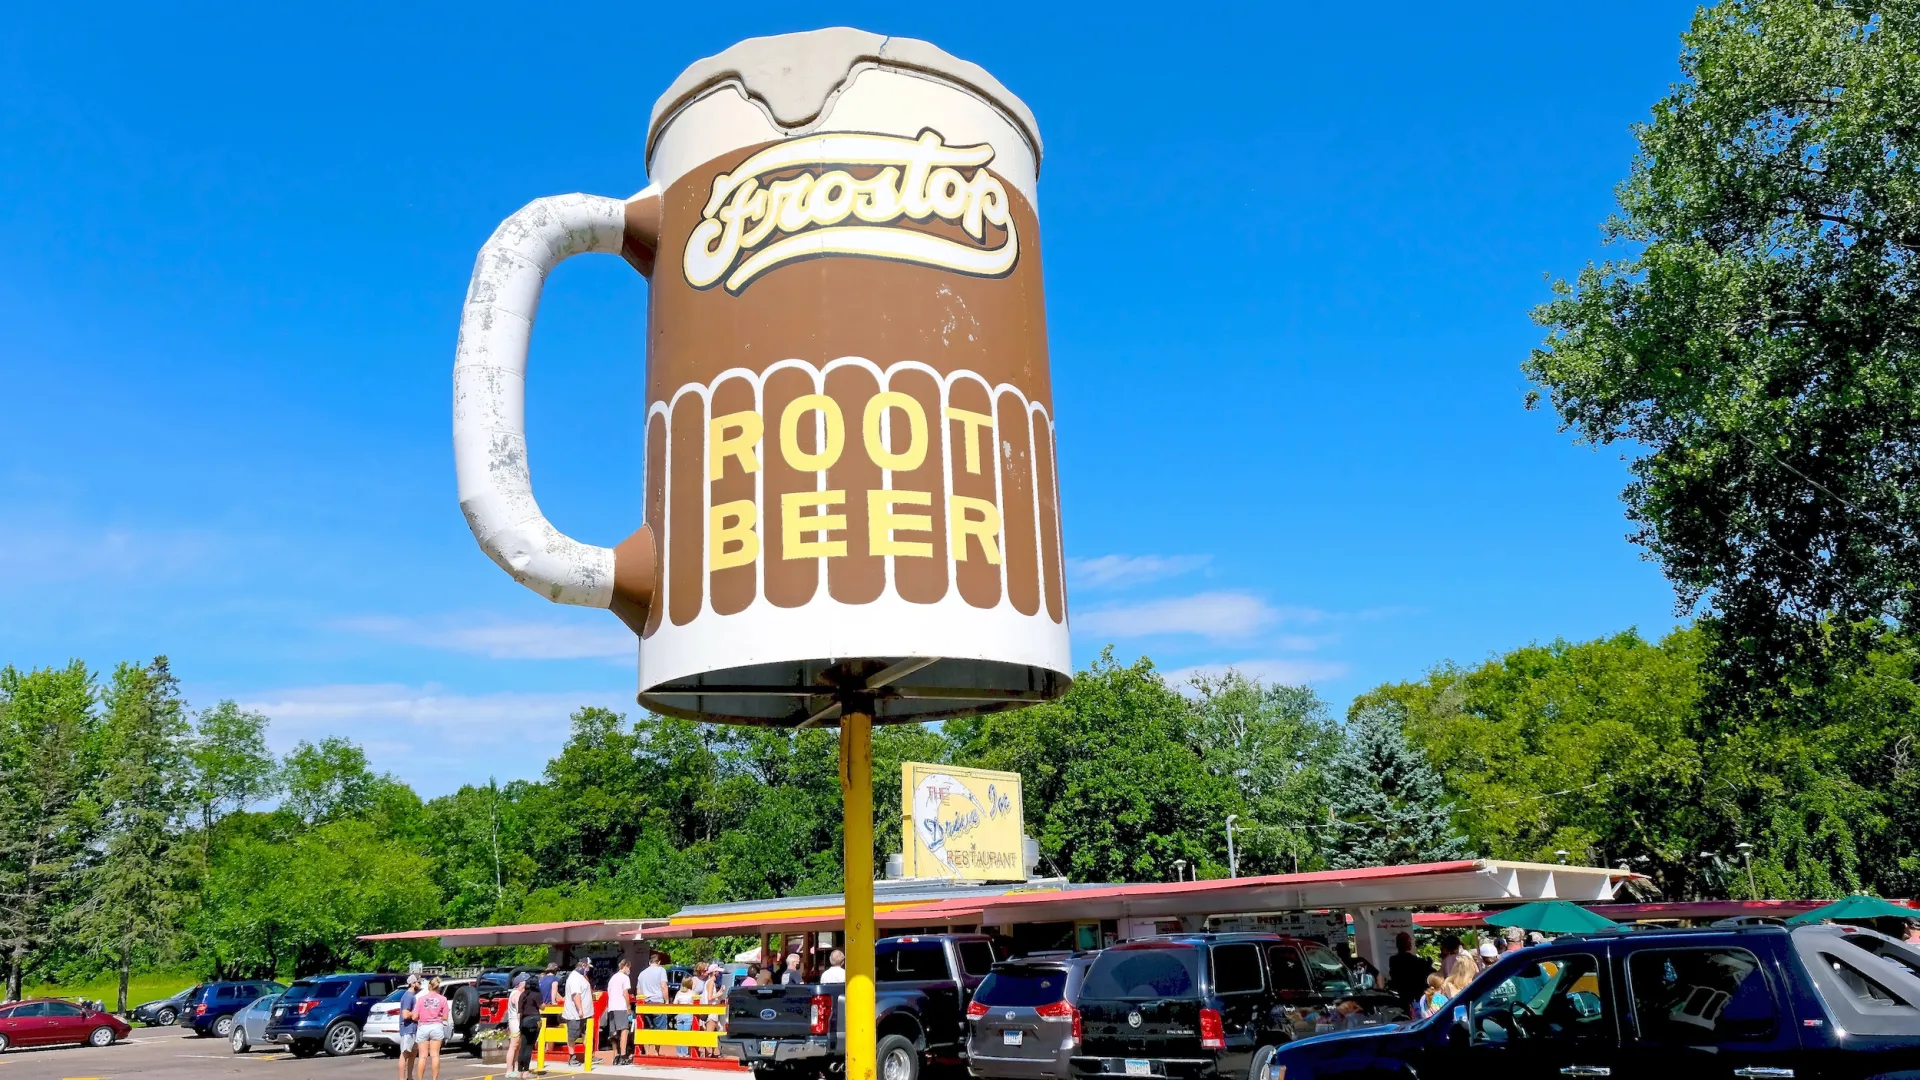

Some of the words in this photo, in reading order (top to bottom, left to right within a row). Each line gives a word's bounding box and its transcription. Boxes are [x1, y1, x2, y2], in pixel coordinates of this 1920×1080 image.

[683, 127, 1020, 296] Frostop
[709, 391, 994, 481] ROOT
[709, 489, 1003, 572] BEER
[926, 785, 951, 803] THE
[923, 808, 980, 852] Drive
[946, 849, 1018, 869] RESTAURANT
